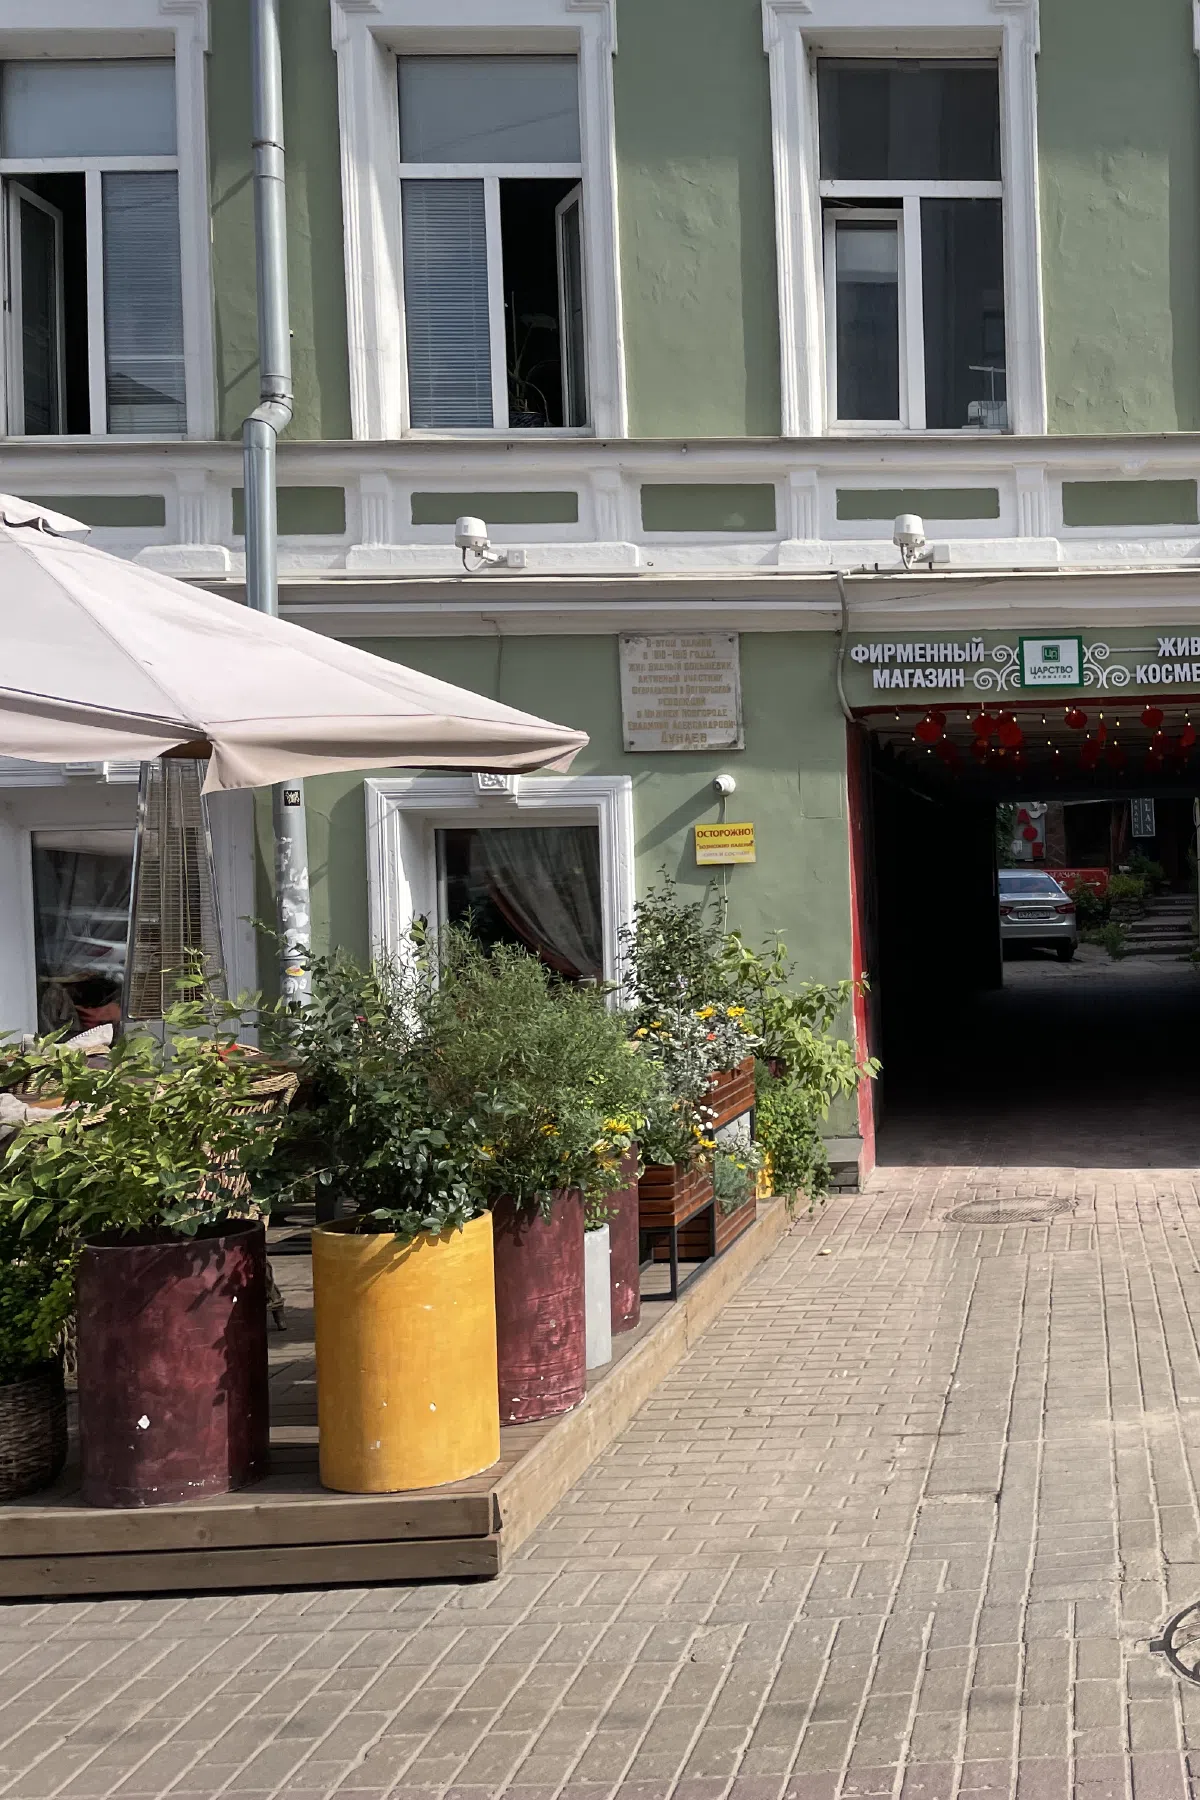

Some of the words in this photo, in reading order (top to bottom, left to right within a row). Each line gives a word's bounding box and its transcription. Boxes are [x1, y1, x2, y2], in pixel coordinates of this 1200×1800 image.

[850, 637, 985, 663] ФИРМЕННЫЙ
[1030, 665, 1073, 675] ЦАРСТВО
[873, 668, 965, 689] МАГАЗИН
[661, 731, 707, 743] ДУНАЕВ
